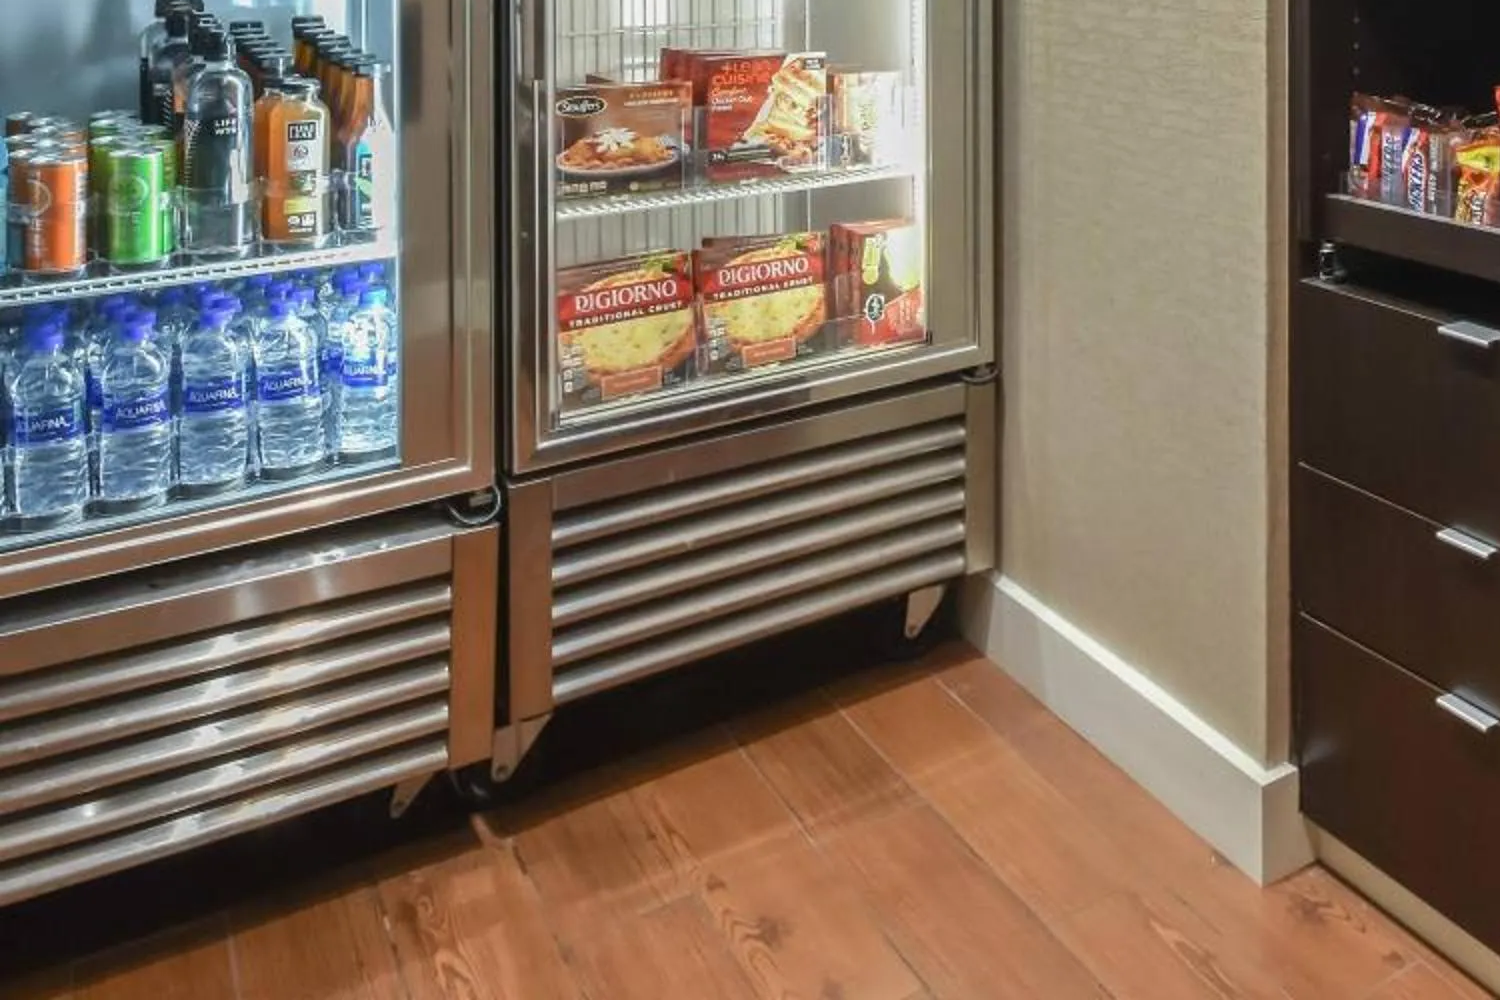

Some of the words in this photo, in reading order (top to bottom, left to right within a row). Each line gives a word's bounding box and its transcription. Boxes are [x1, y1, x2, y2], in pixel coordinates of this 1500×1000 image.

[719, 256, 810, 287] DIGIORNO
[575, 279, 678, 314] DIGIORNO
[713, 281, 781, 301] TRADITIONAL
[568, 309, 645, 329] TRADITIONAL
[649, 300, 683, 314] CRUST
